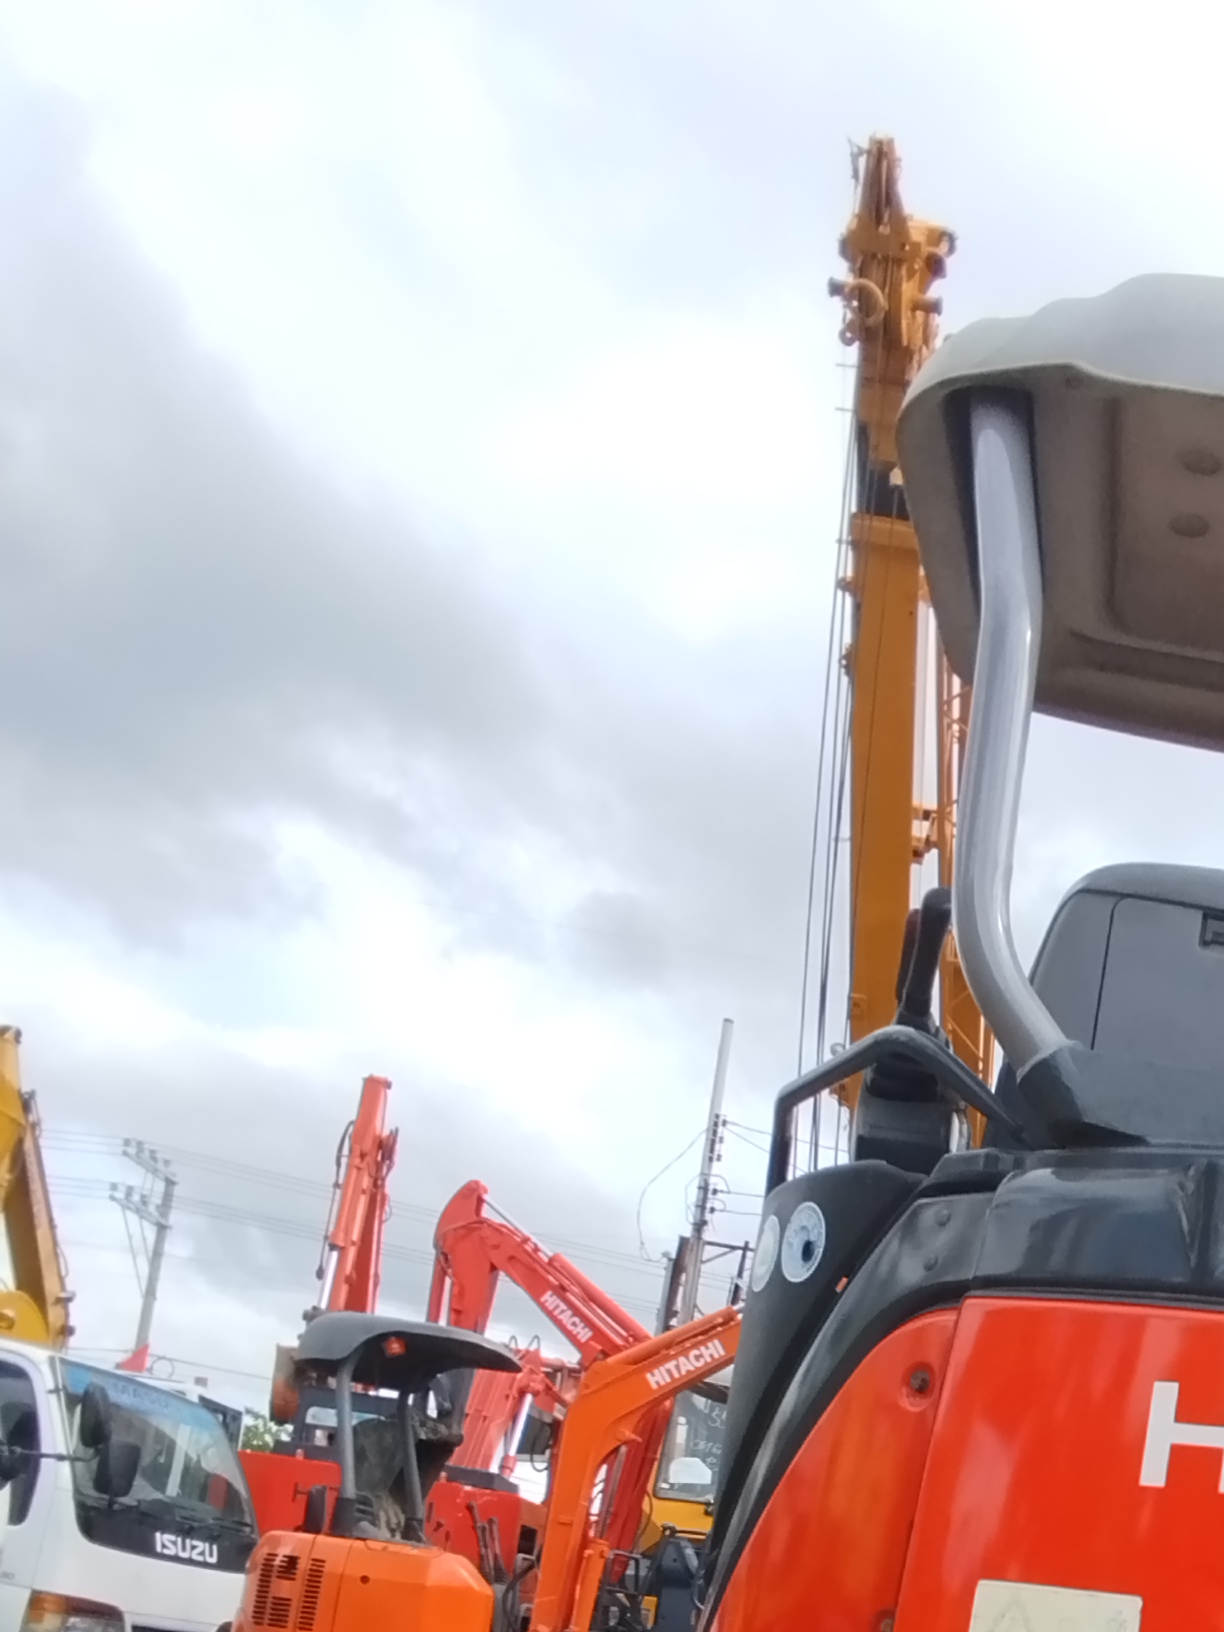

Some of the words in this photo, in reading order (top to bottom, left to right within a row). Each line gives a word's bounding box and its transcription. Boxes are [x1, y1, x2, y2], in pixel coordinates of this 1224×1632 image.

[540, 1290, 594, 1343] HITACHI
[645, 1339, 726, 1390] HITACHI
[155, 1531, 218, 1564] ISUZU
